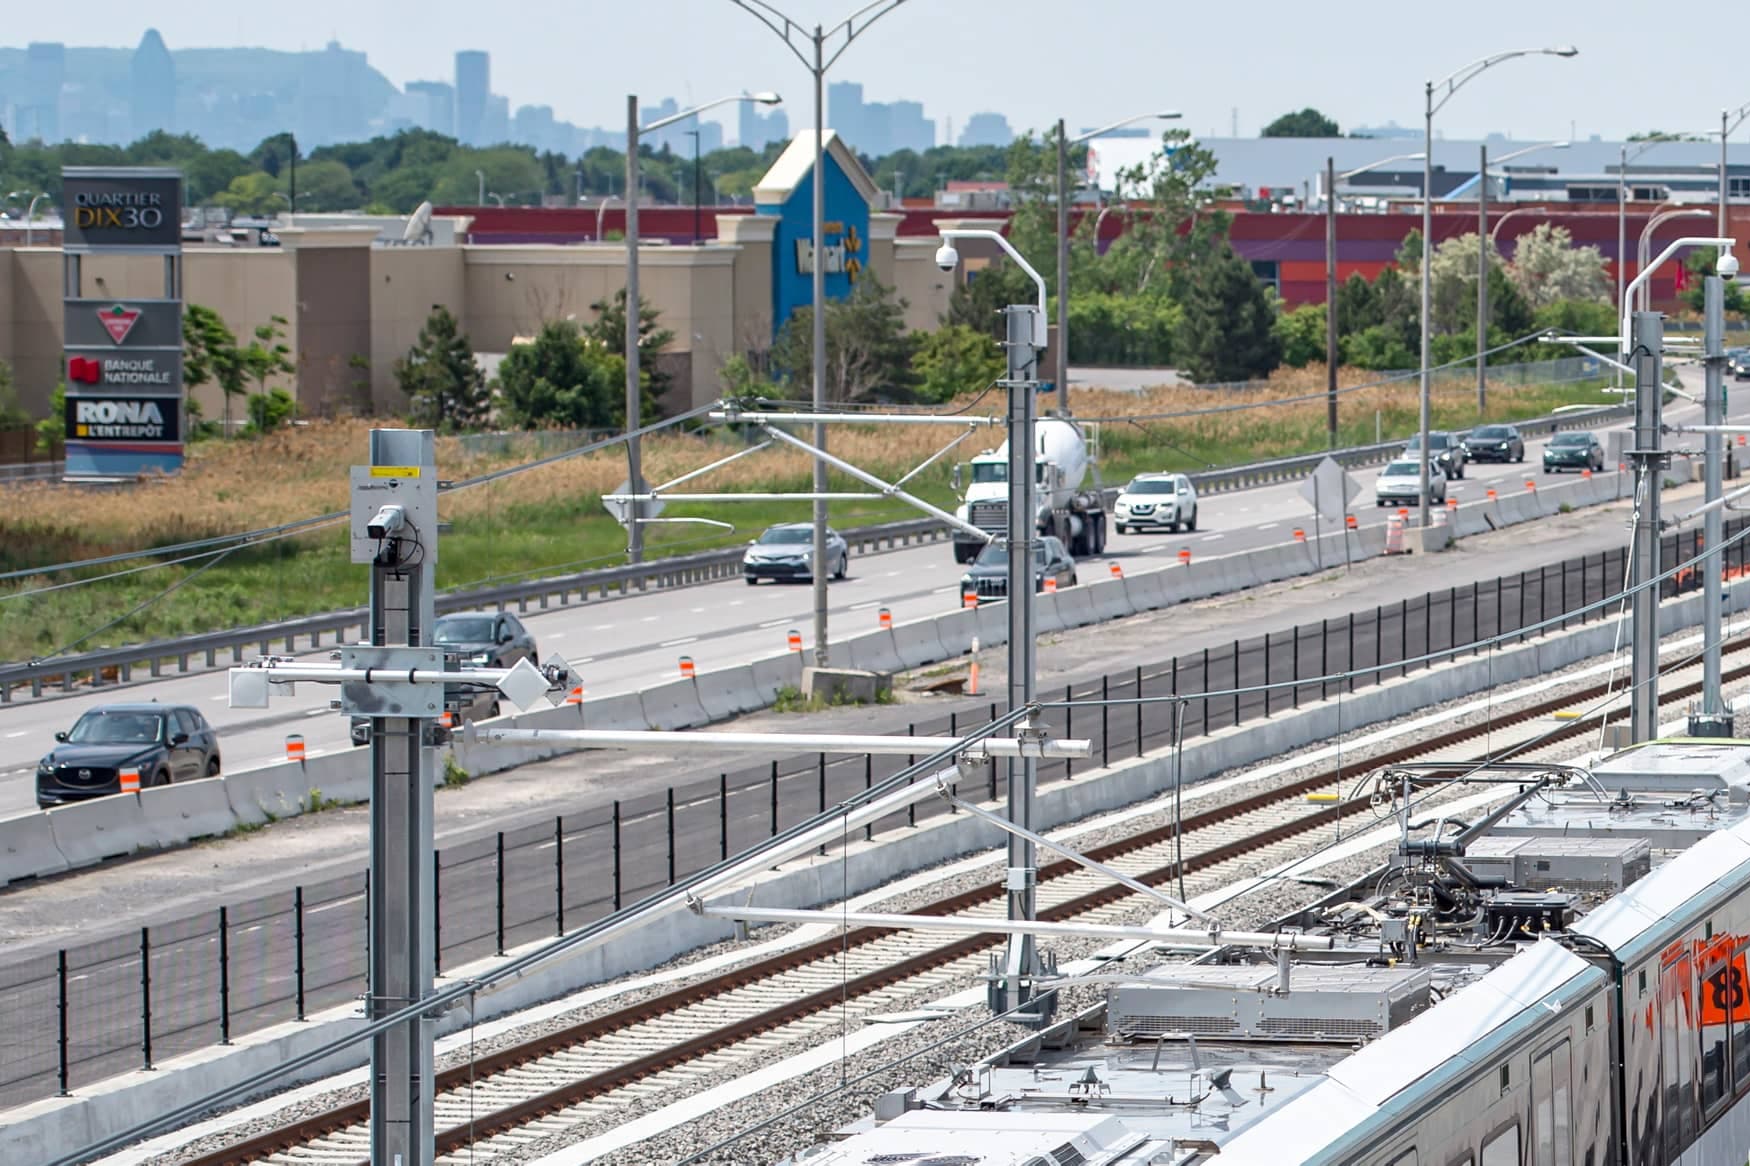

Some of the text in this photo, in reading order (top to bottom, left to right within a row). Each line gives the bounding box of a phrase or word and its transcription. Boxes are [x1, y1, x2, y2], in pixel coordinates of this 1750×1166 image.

[75, 192, 161, 206] QUARTIER
[74, 207, 163, 228] DIX30
[104, 359, 155, 371] BANQUE
[104, 371, 170, 384] NATIONALE
[76, 401, 164, 424] RONA
[88, 423, 164, 437] L'ENTREPÔT
